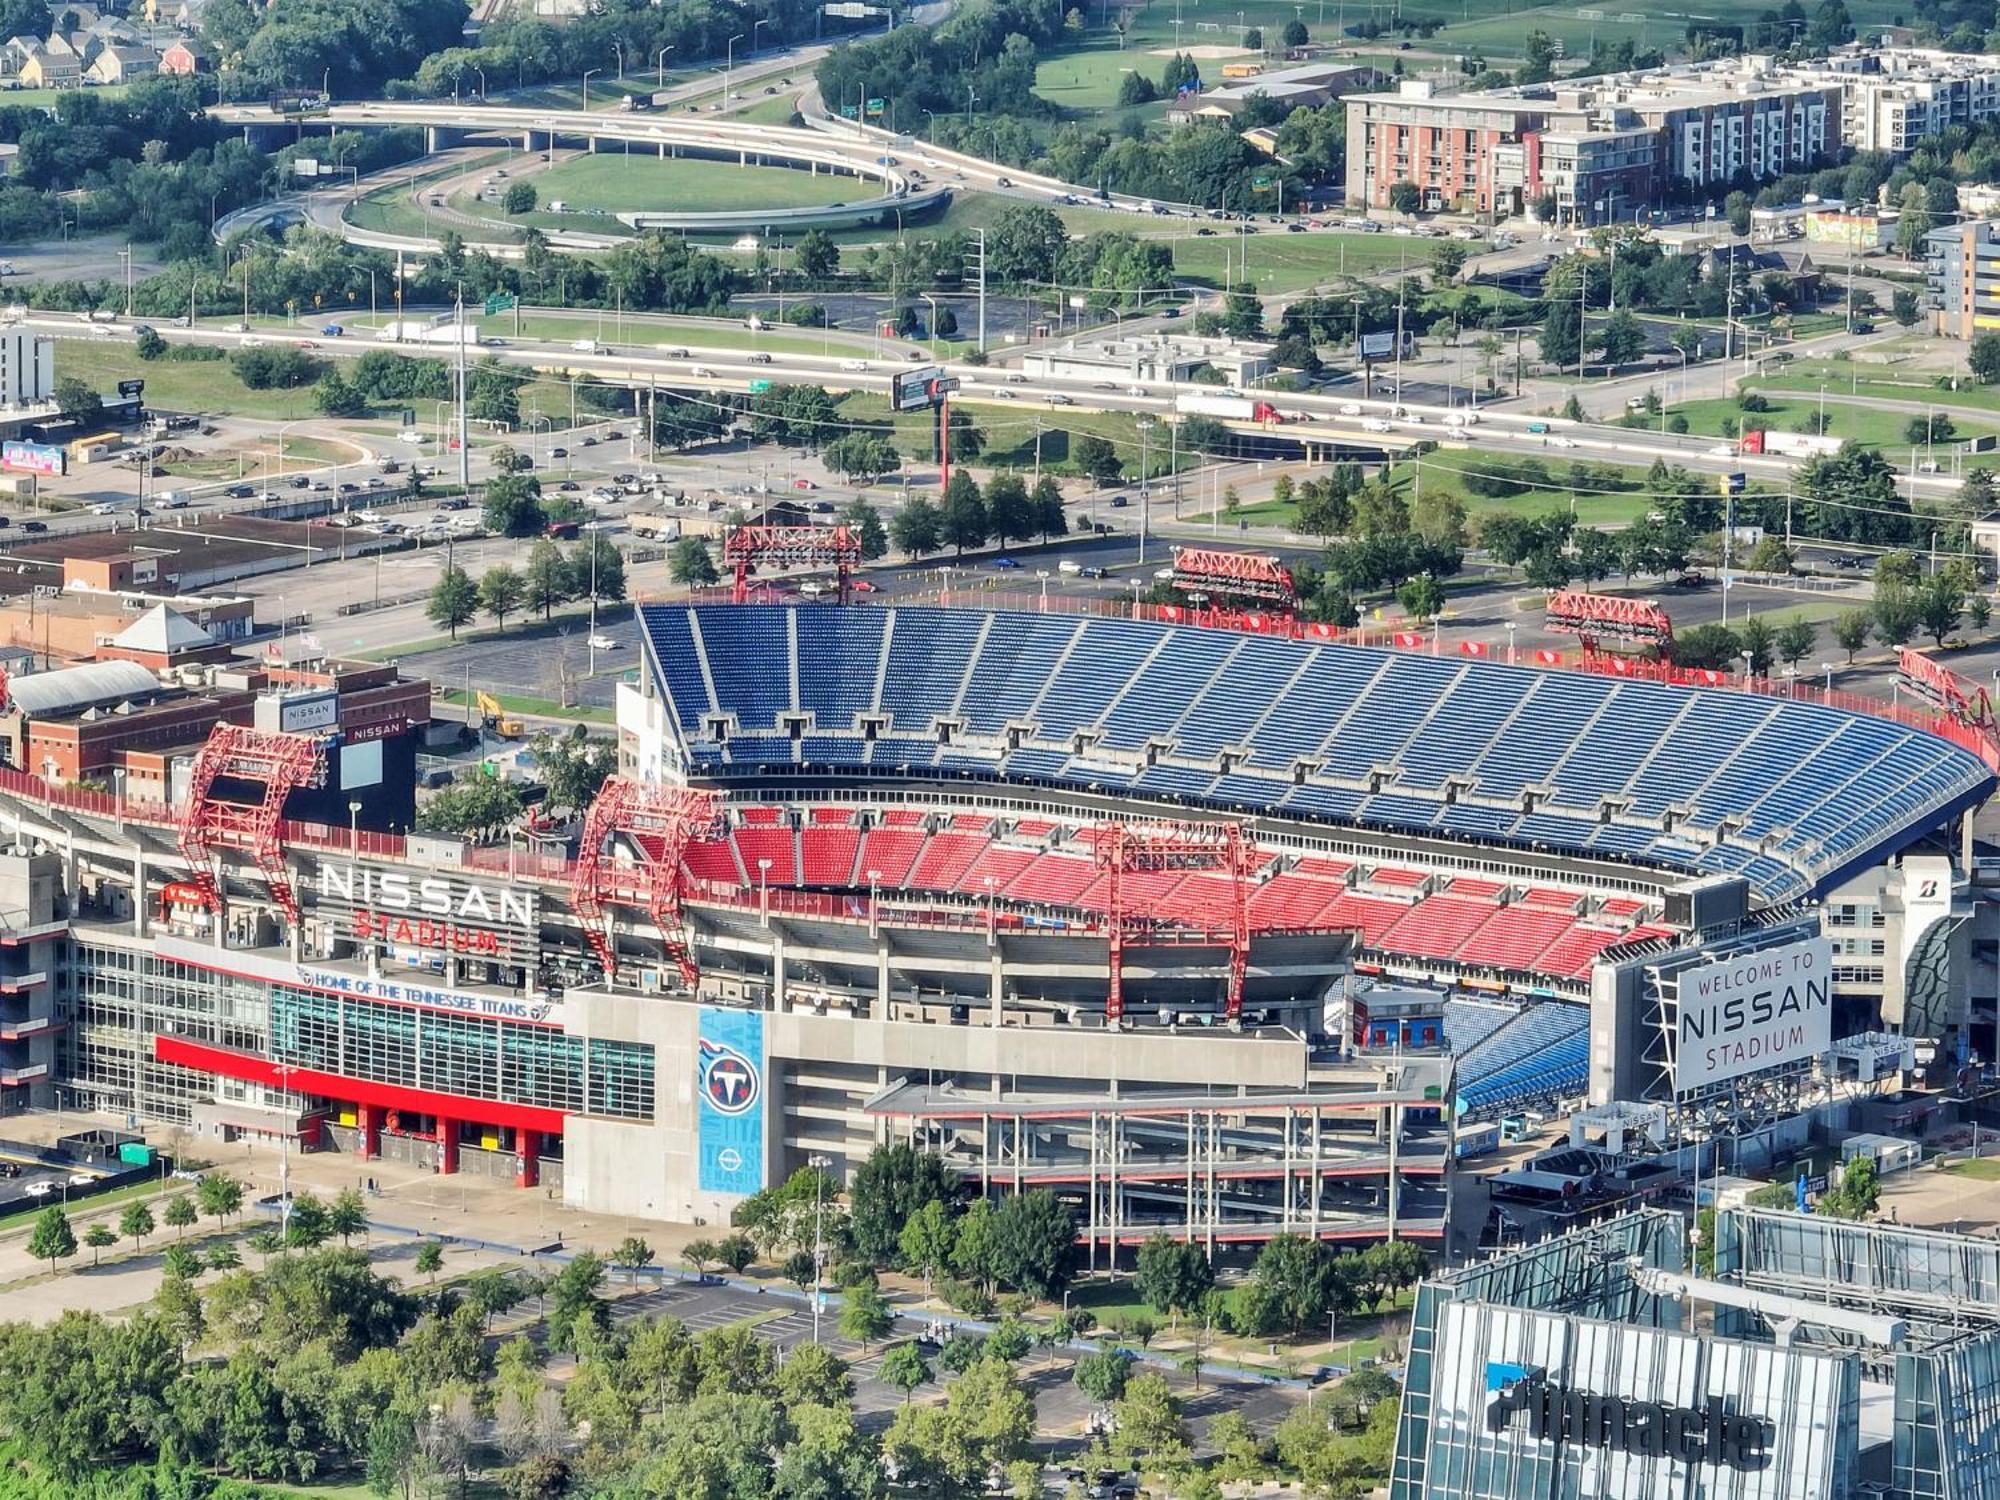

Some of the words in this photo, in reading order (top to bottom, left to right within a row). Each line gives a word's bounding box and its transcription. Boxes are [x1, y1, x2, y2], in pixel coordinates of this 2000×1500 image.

[289, 705, 329, 719] NISSAN
[354, 723, 400, 739] NISSAN
[322, 863, 533, 926] NISSAN
[355, 909, 497, 955] STADIUM
[315, 973, 351, 992] HOME
[355, 981, 372, 994] OF
[376, 984, 400, 999] THE
[404, 988, 476, 1010] TENNESSEE
[480, 999, 526, 1016] TITANS
[1699, 960, 1782, 997] WELCOME
[1792, 952, 1813, 972] TO
[1683, 976, 1828, 1044] NISSAN
[1706, 1025, 1804, 1071] STADIUM
[1874, 1042, 1909, 1057] NISSAN
[1623, 1111, 1659, 1127] NISSAN
